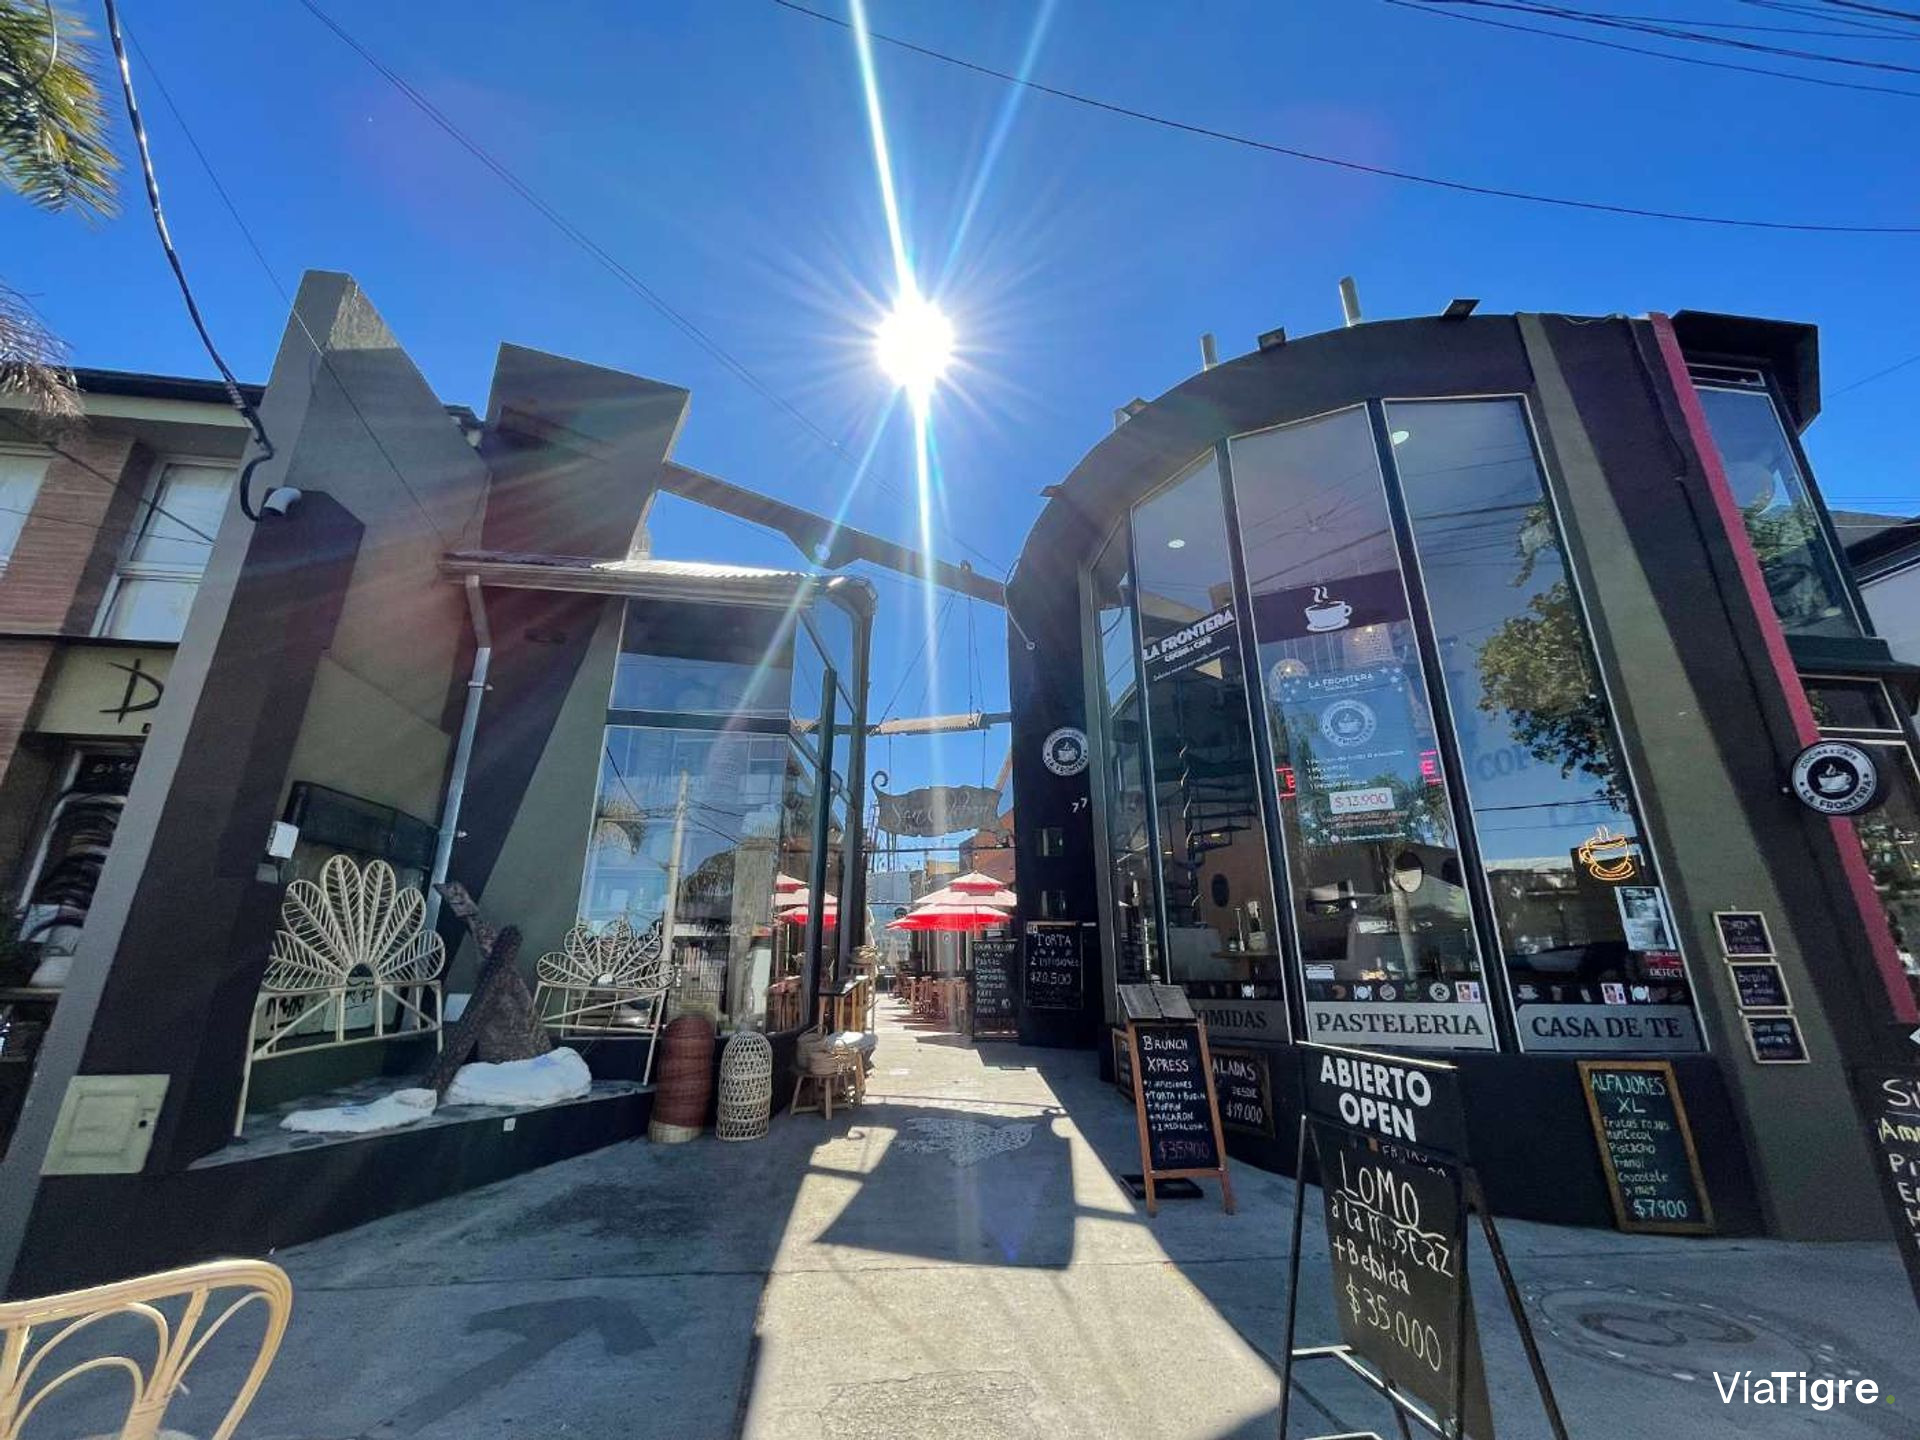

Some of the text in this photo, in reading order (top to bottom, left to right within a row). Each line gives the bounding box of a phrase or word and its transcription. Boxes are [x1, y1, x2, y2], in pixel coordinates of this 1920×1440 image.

[1143, 609, 1235, 661] LA FRONTERA
[1819, 779, 1873, 810] FRONTERA
[1034, 933, 1072, 947] TORTA
[1196, 1008, 1268, 1030] OMIDAS
[1315, 1012, 1484, 1035] PASTELERIA
[1532, 1016, 1683, 1038] CASA DE TE
[1142, 1035, 1188, 1051] BRUNCH
[1147, 1055, 1189, 1073] XPRESS
[1320, 1055, 1432, 1107] ABIERTO
[1591, 1072, 1667, 1096] ALFAJORES
[1616, 1097, 1647, 1113] XL
[1339, 1092, 1417, 1143] OPEN
[1339, 1149, 1420, 1229] LOMO
